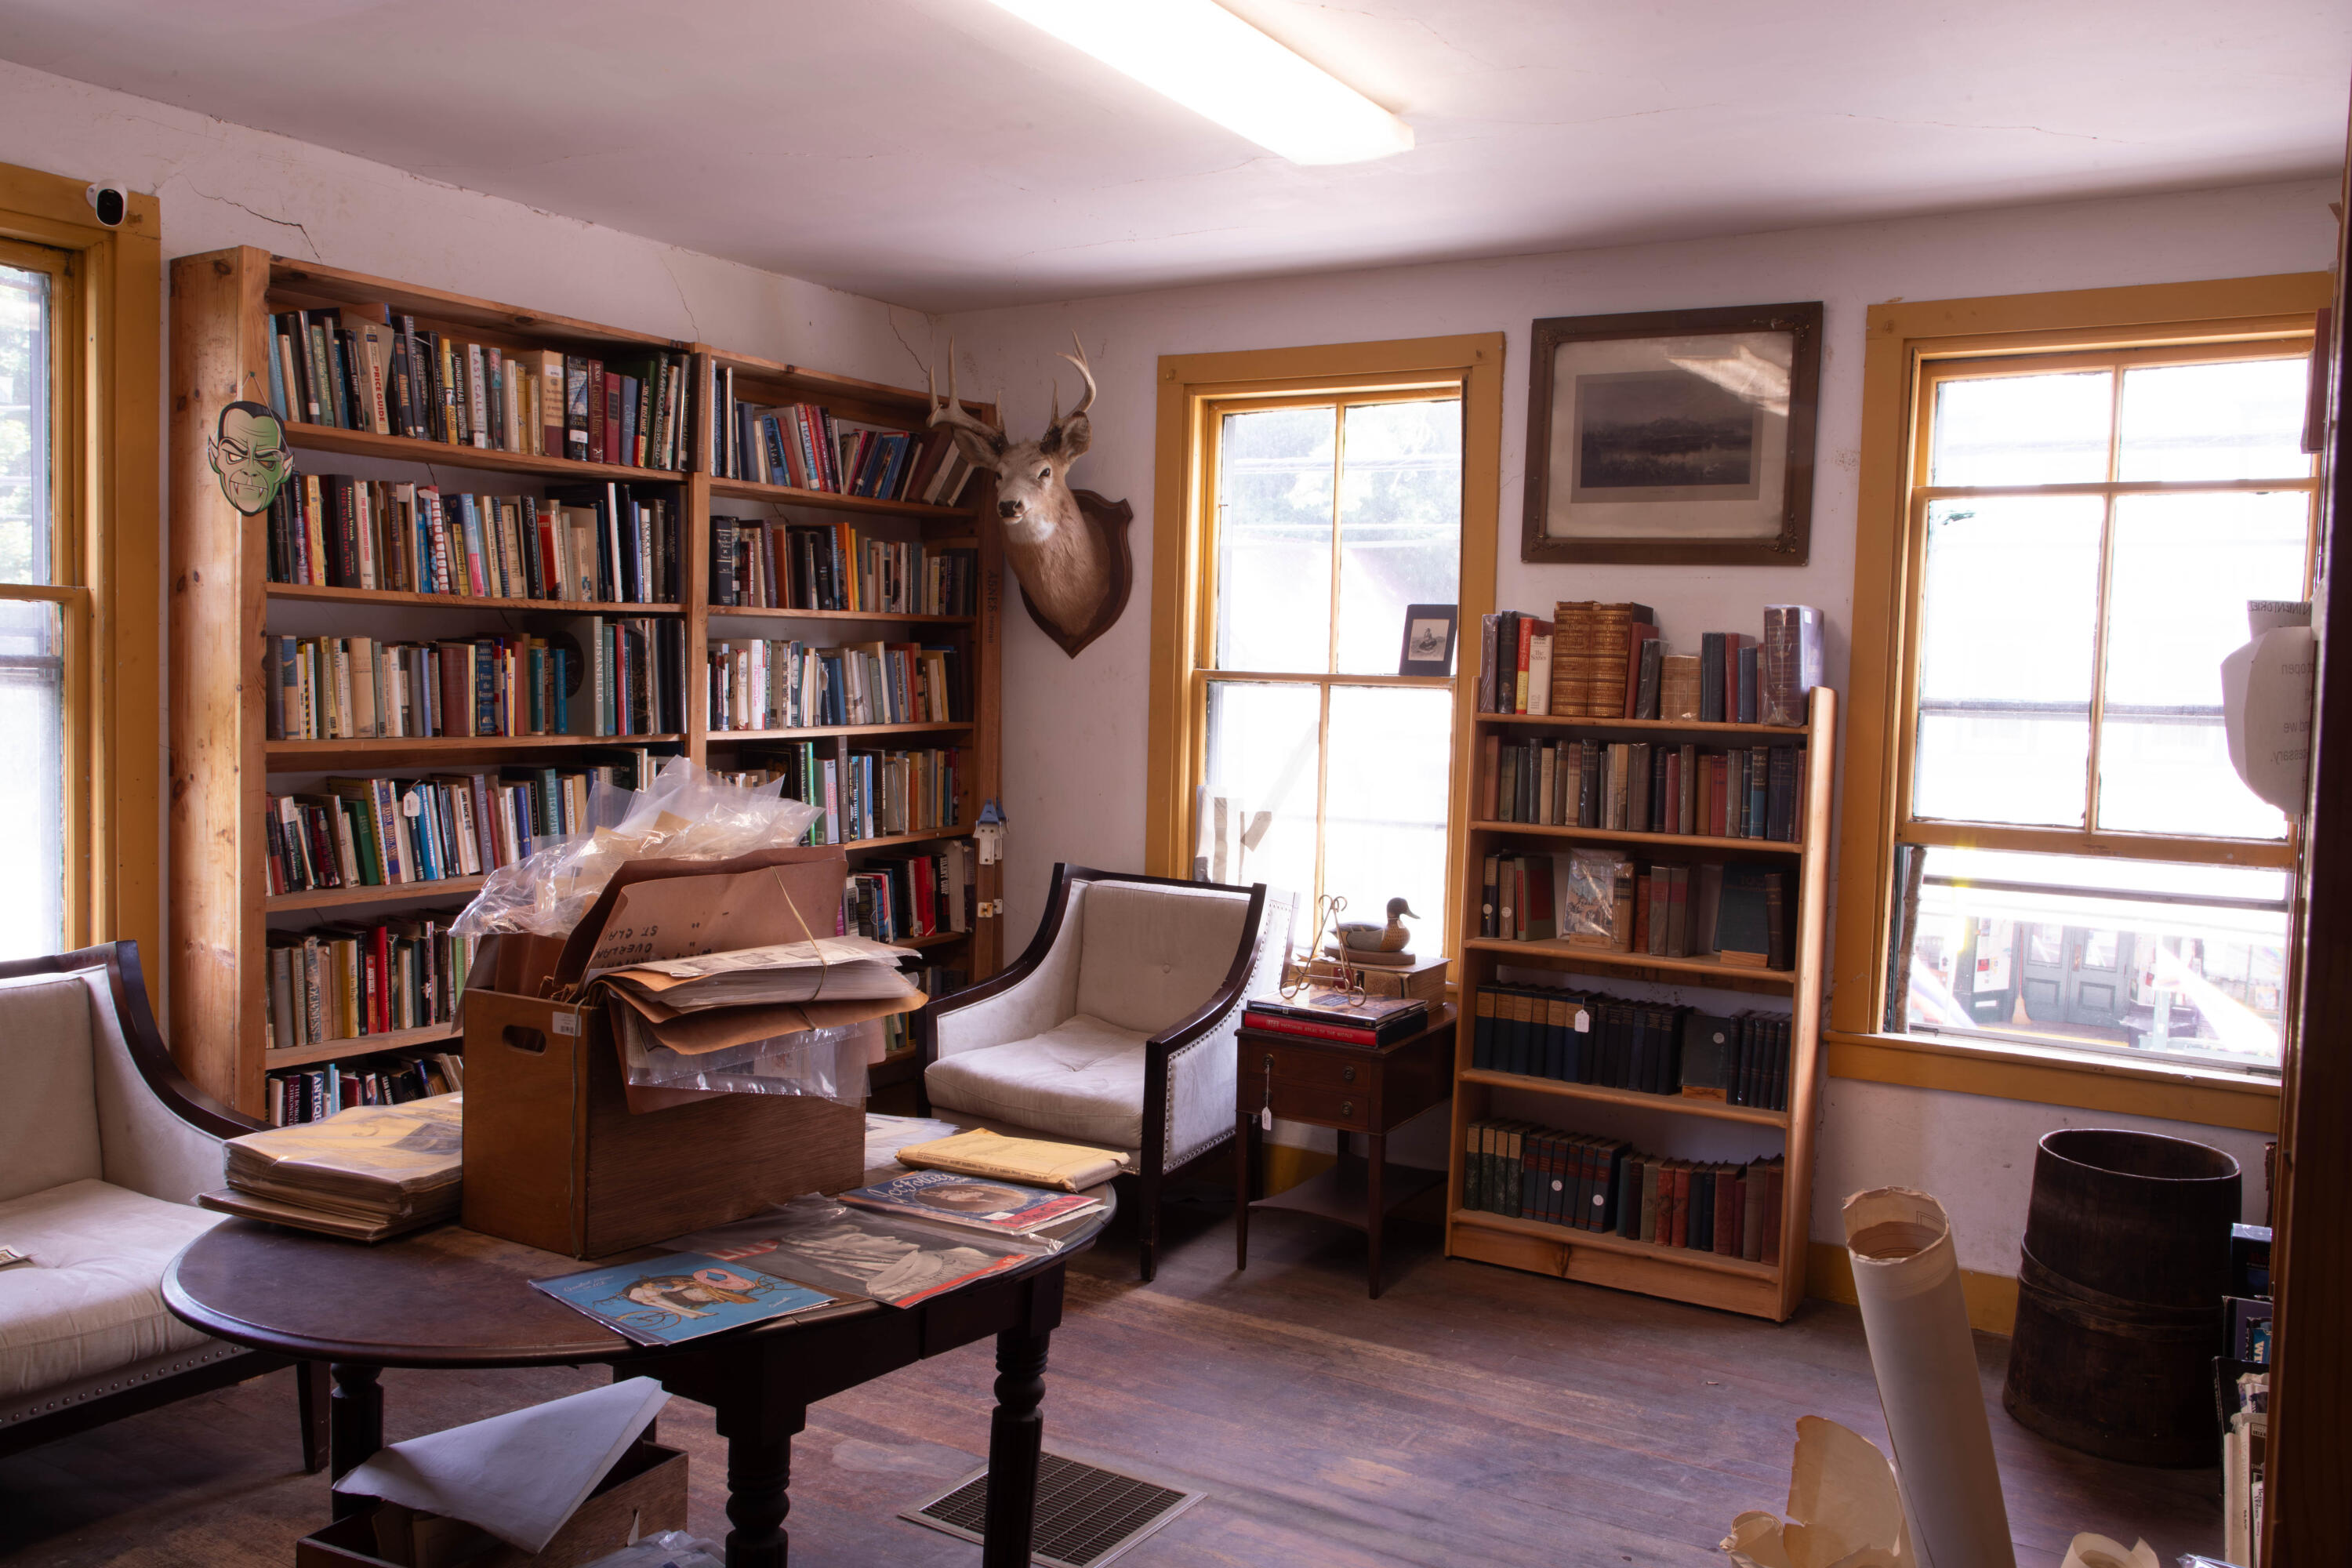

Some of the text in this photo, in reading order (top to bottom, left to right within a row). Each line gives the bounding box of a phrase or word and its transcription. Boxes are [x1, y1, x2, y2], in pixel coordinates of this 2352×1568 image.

[455, 357, 465, 402] THUNDERHEAD
[660, 358, 669, 376] SAUDI
[372, 365, 386, 423] PRICE GUIDE
[398, 374, 409, 408] ADMIRAL
[472, 351, 483, 414] LAST CALL
[658, 376, 667, 408] ARAMCO
[640, 405, 649, 434] ROSEMARY
[657, 408, 666, 424] AND
[655, 432, 664, 459] WORLD
[343, 541, 349, 553] OF
[457, 540, 466, 572] discovery
[595, 639, 604, 702] PISANELLO
[461, 791, 469, 802] MR
[387, 824, 397, 855] BROKAW
[290, 851, 299, 880] Anderson
[940, 880, 949, 895] COUP
[640, 925, 659, 937] ST.
[382, 1076, 390, 1090] SEAN
[923, 1154, 948, 1163] EDUCATIONAL
[705, 1241, 779, 1261] LIFE
